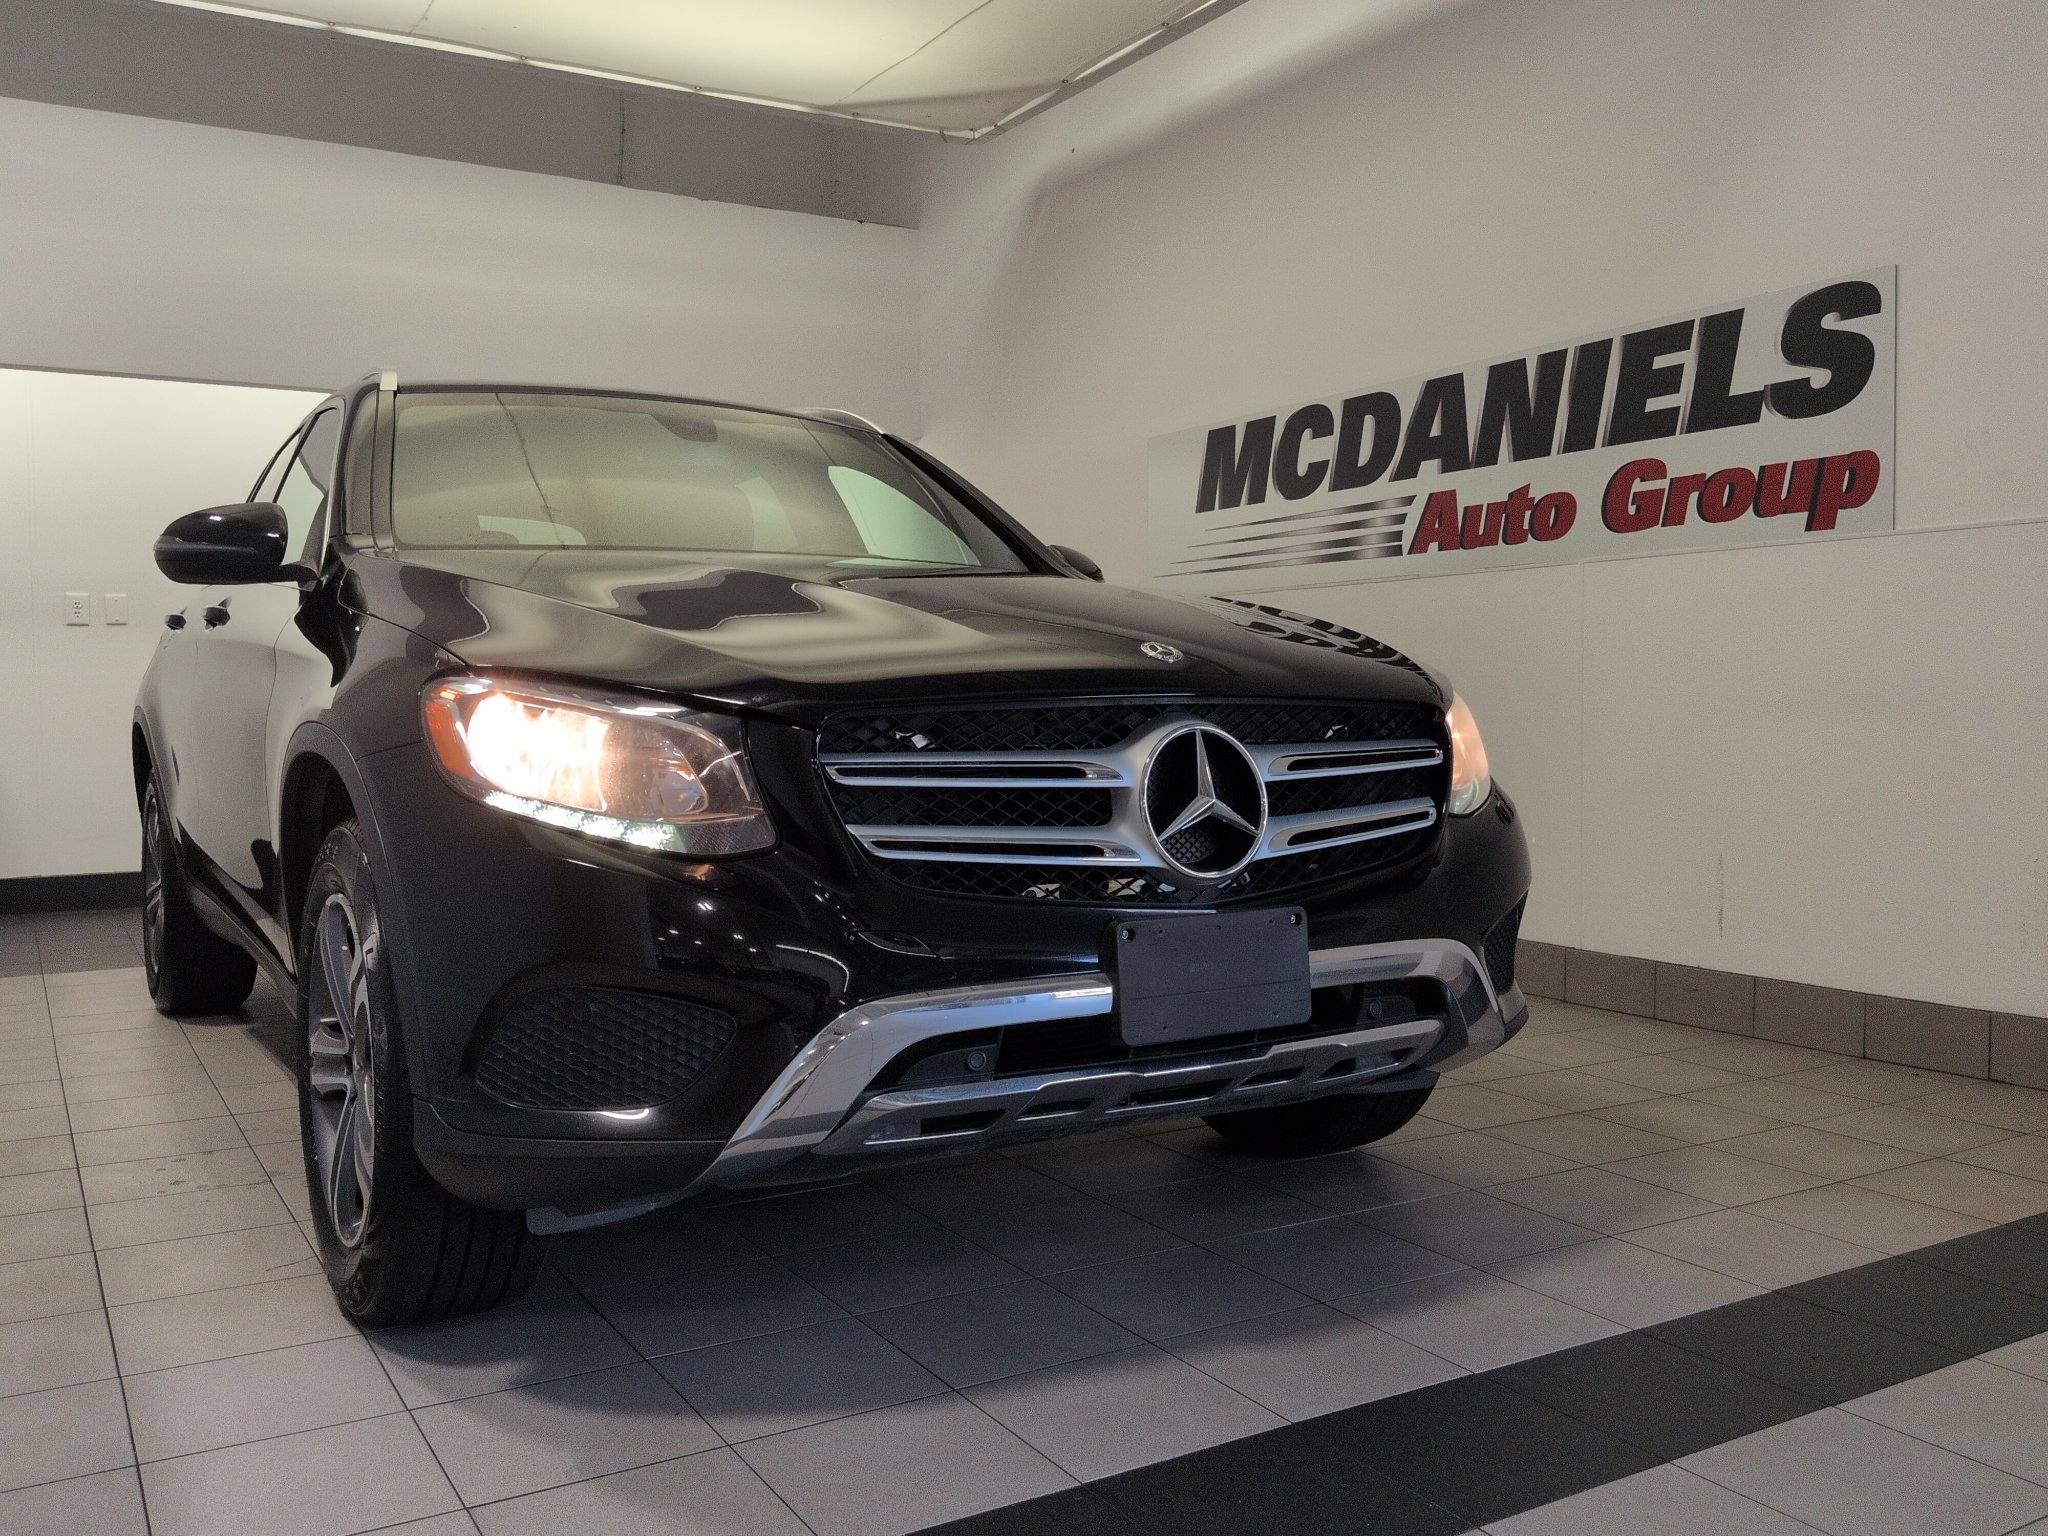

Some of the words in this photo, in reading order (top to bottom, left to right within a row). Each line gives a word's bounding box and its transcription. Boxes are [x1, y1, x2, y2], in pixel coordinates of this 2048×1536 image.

[1195, 280, 1882, 514] MCDANIELS
[1406, 481, 1578, 556] Auto
[1600, 448, 1881, 533] Group
